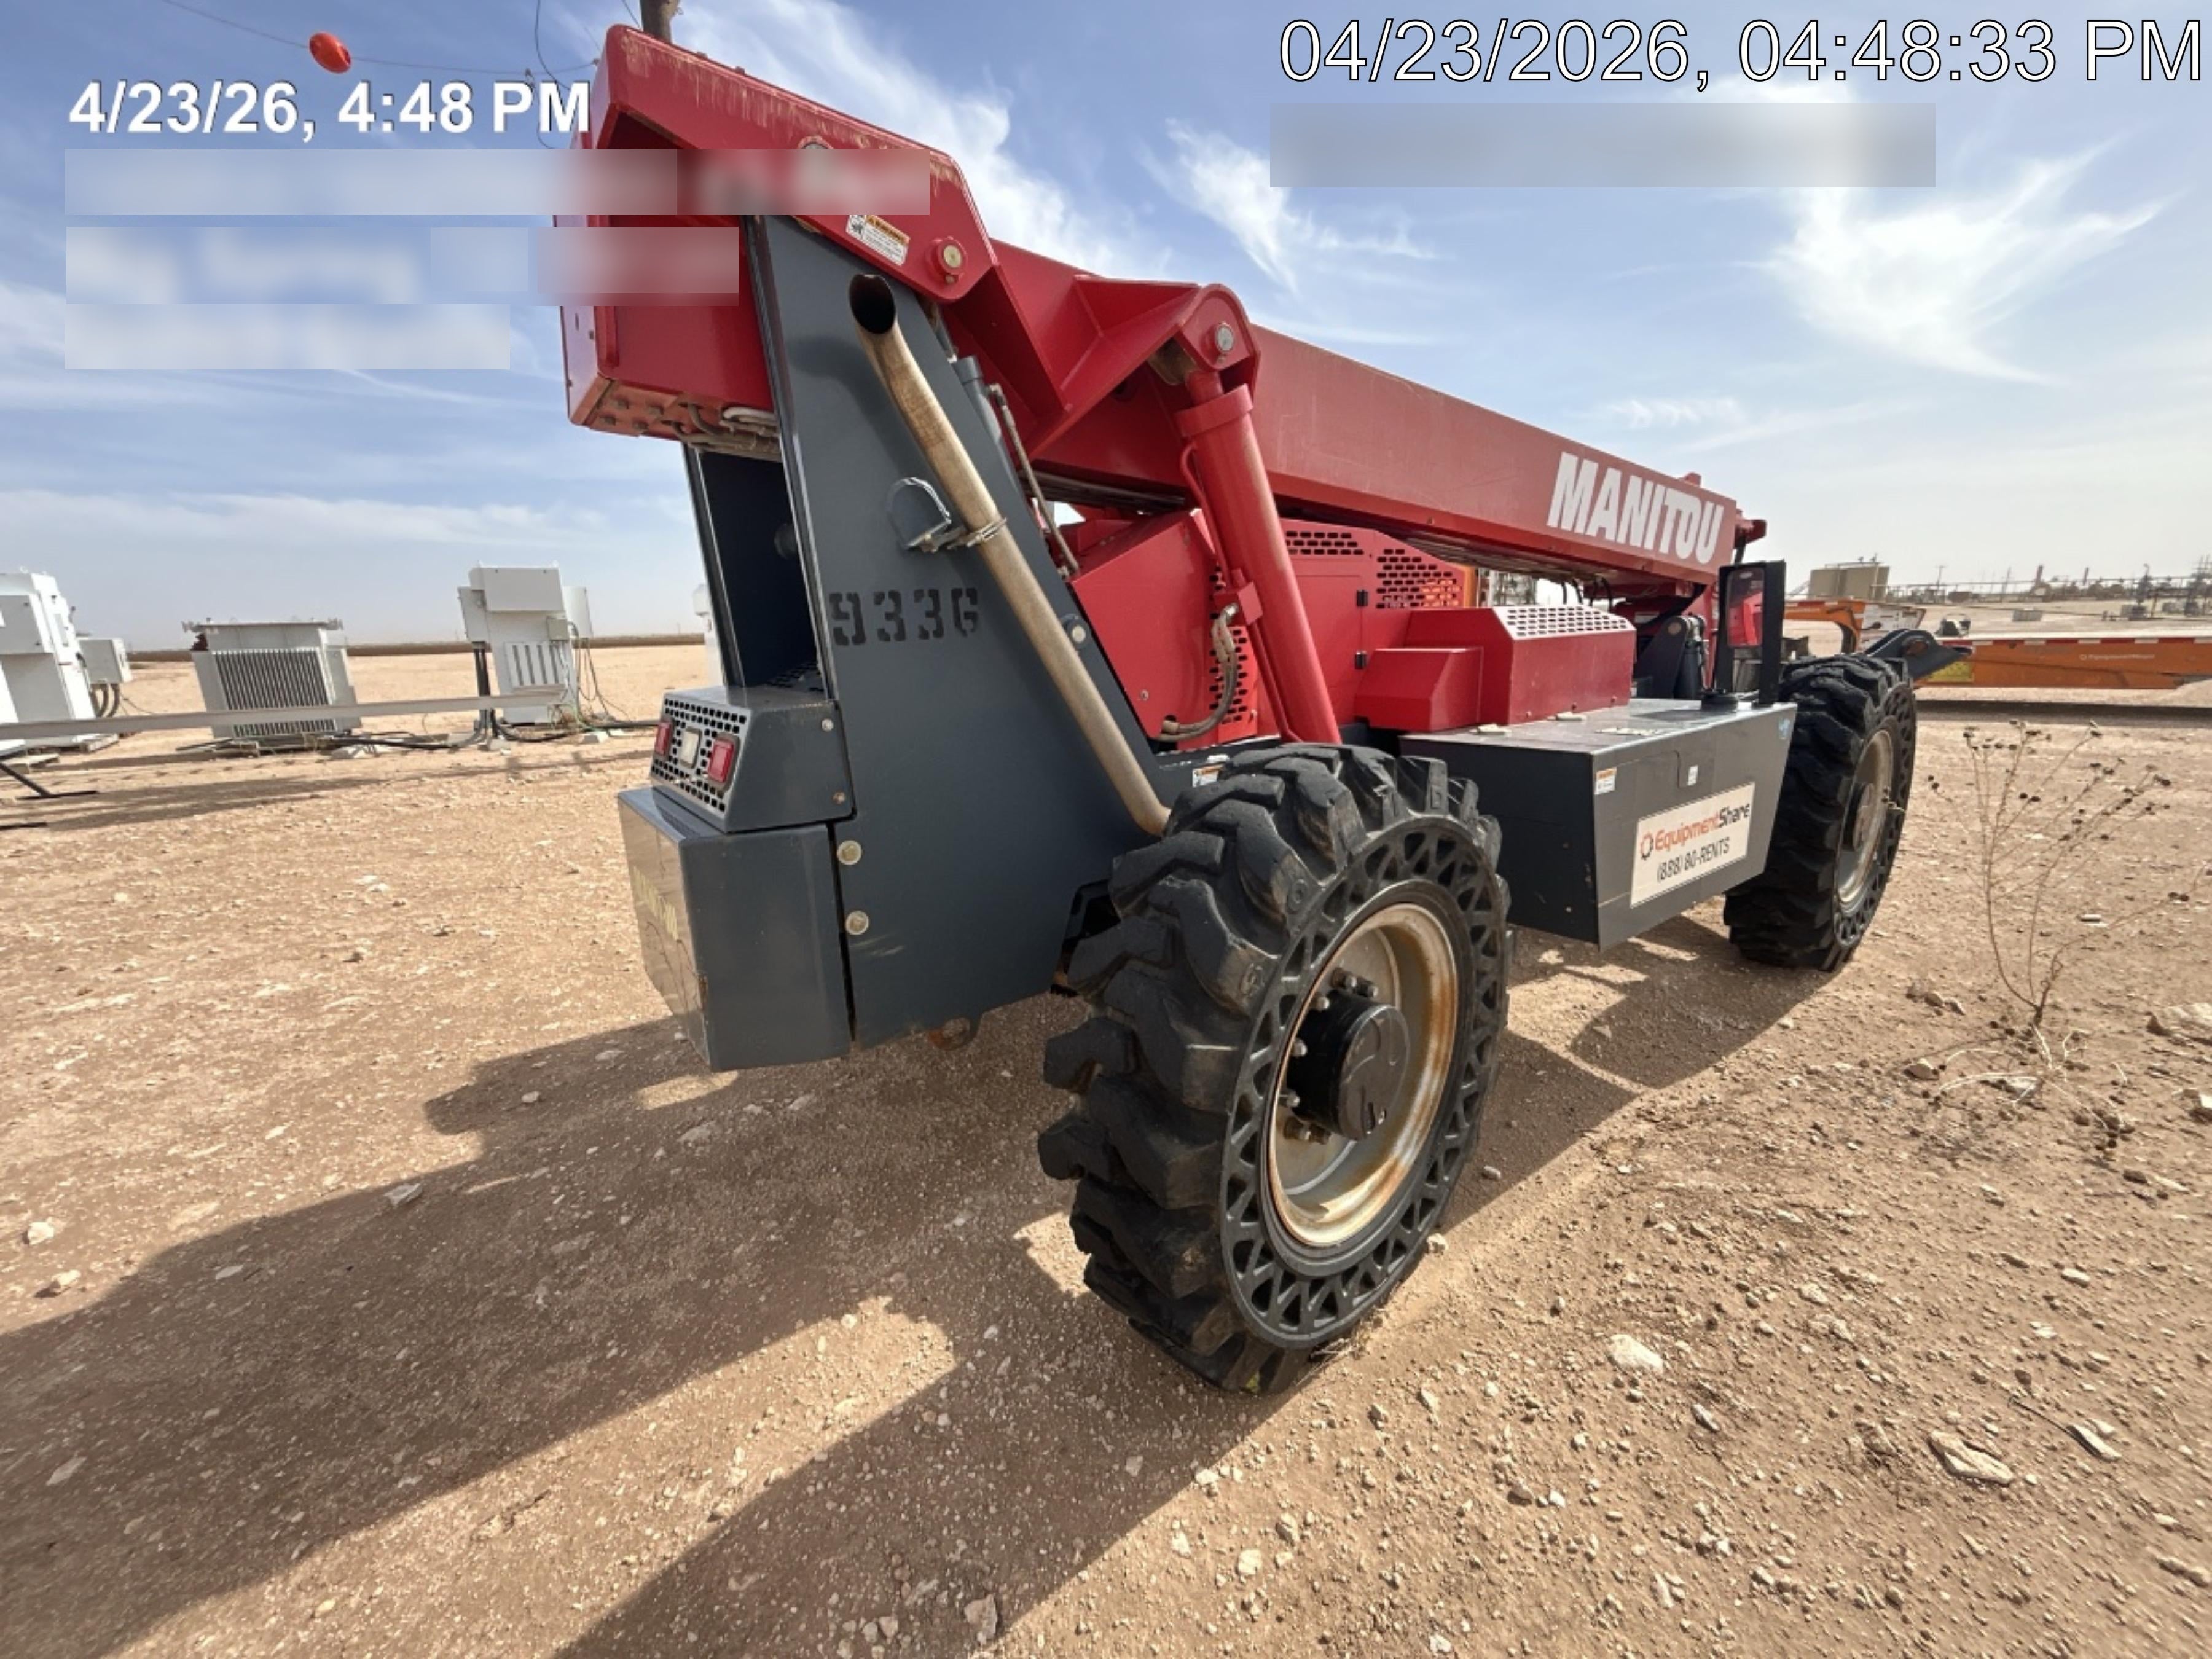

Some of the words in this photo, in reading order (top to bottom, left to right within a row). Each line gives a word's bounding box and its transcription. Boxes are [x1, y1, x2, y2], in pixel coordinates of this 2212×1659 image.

[1547, 452, 1724, 565] MANITOU
[1655, 803, 1751, 852] EquipmentShare
[1684, 836, 1730, 871] 80-RENTS
